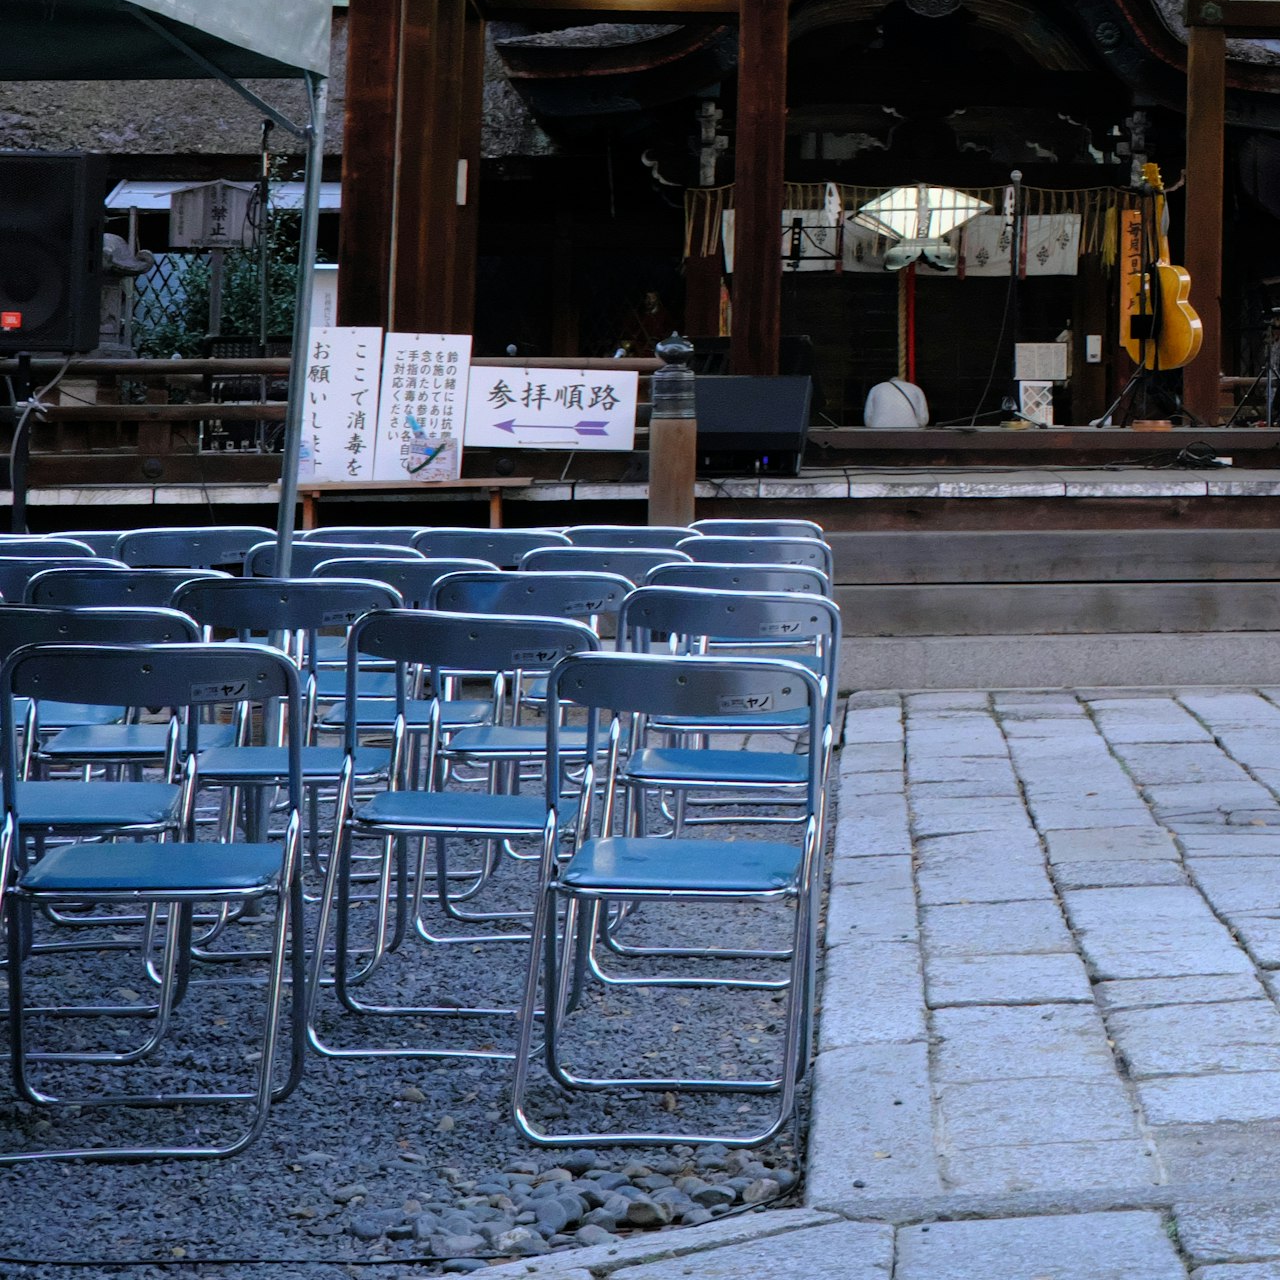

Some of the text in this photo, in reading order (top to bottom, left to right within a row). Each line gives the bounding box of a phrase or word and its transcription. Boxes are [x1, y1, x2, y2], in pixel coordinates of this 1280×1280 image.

[344, 343, 369, 477] ここで消毒を
[387, 350, 407, 440] ご対応ください
[487, 378, 621, 411] 参拝順路
[221, 683, 246, 697] ヤノ
[746, 696, 769, 708] ヤノ
